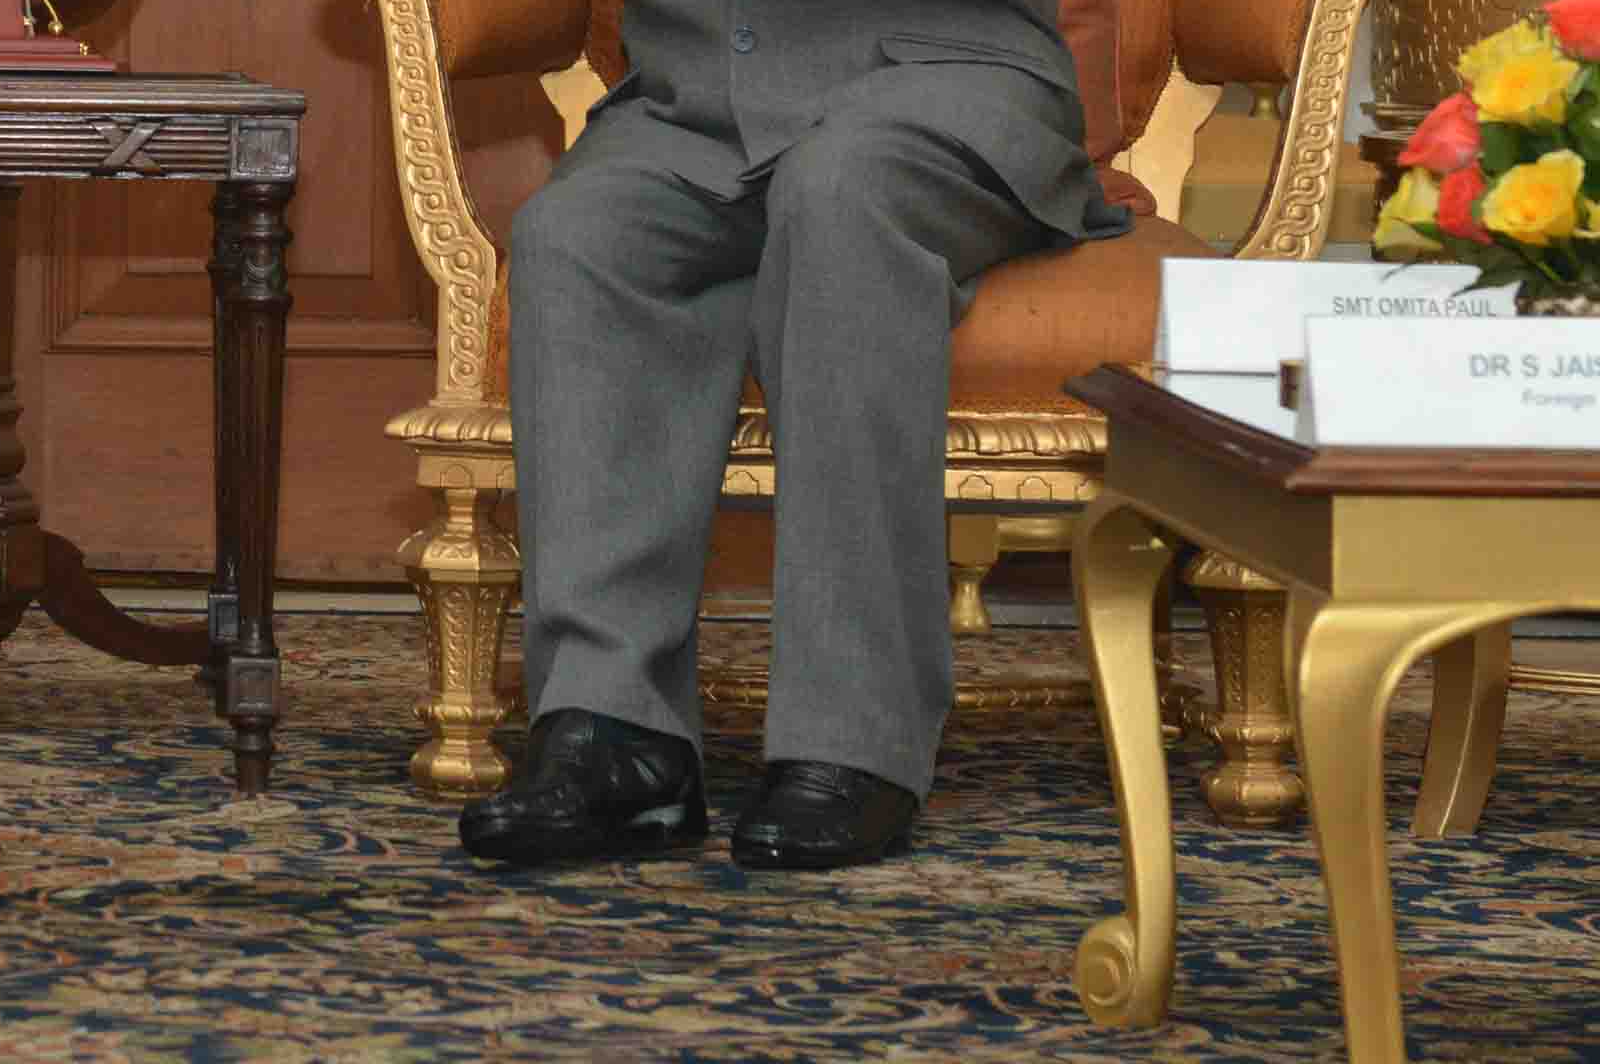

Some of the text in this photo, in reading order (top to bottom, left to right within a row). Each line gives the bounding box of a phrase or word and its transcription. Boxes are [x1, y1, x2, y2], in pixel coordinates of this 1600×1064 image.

[1332, 296, 1498, 319] SMT OMITA PAUL
[1468, 353, 1512, 378] DR
[1520, 353, 1540, 378] S
